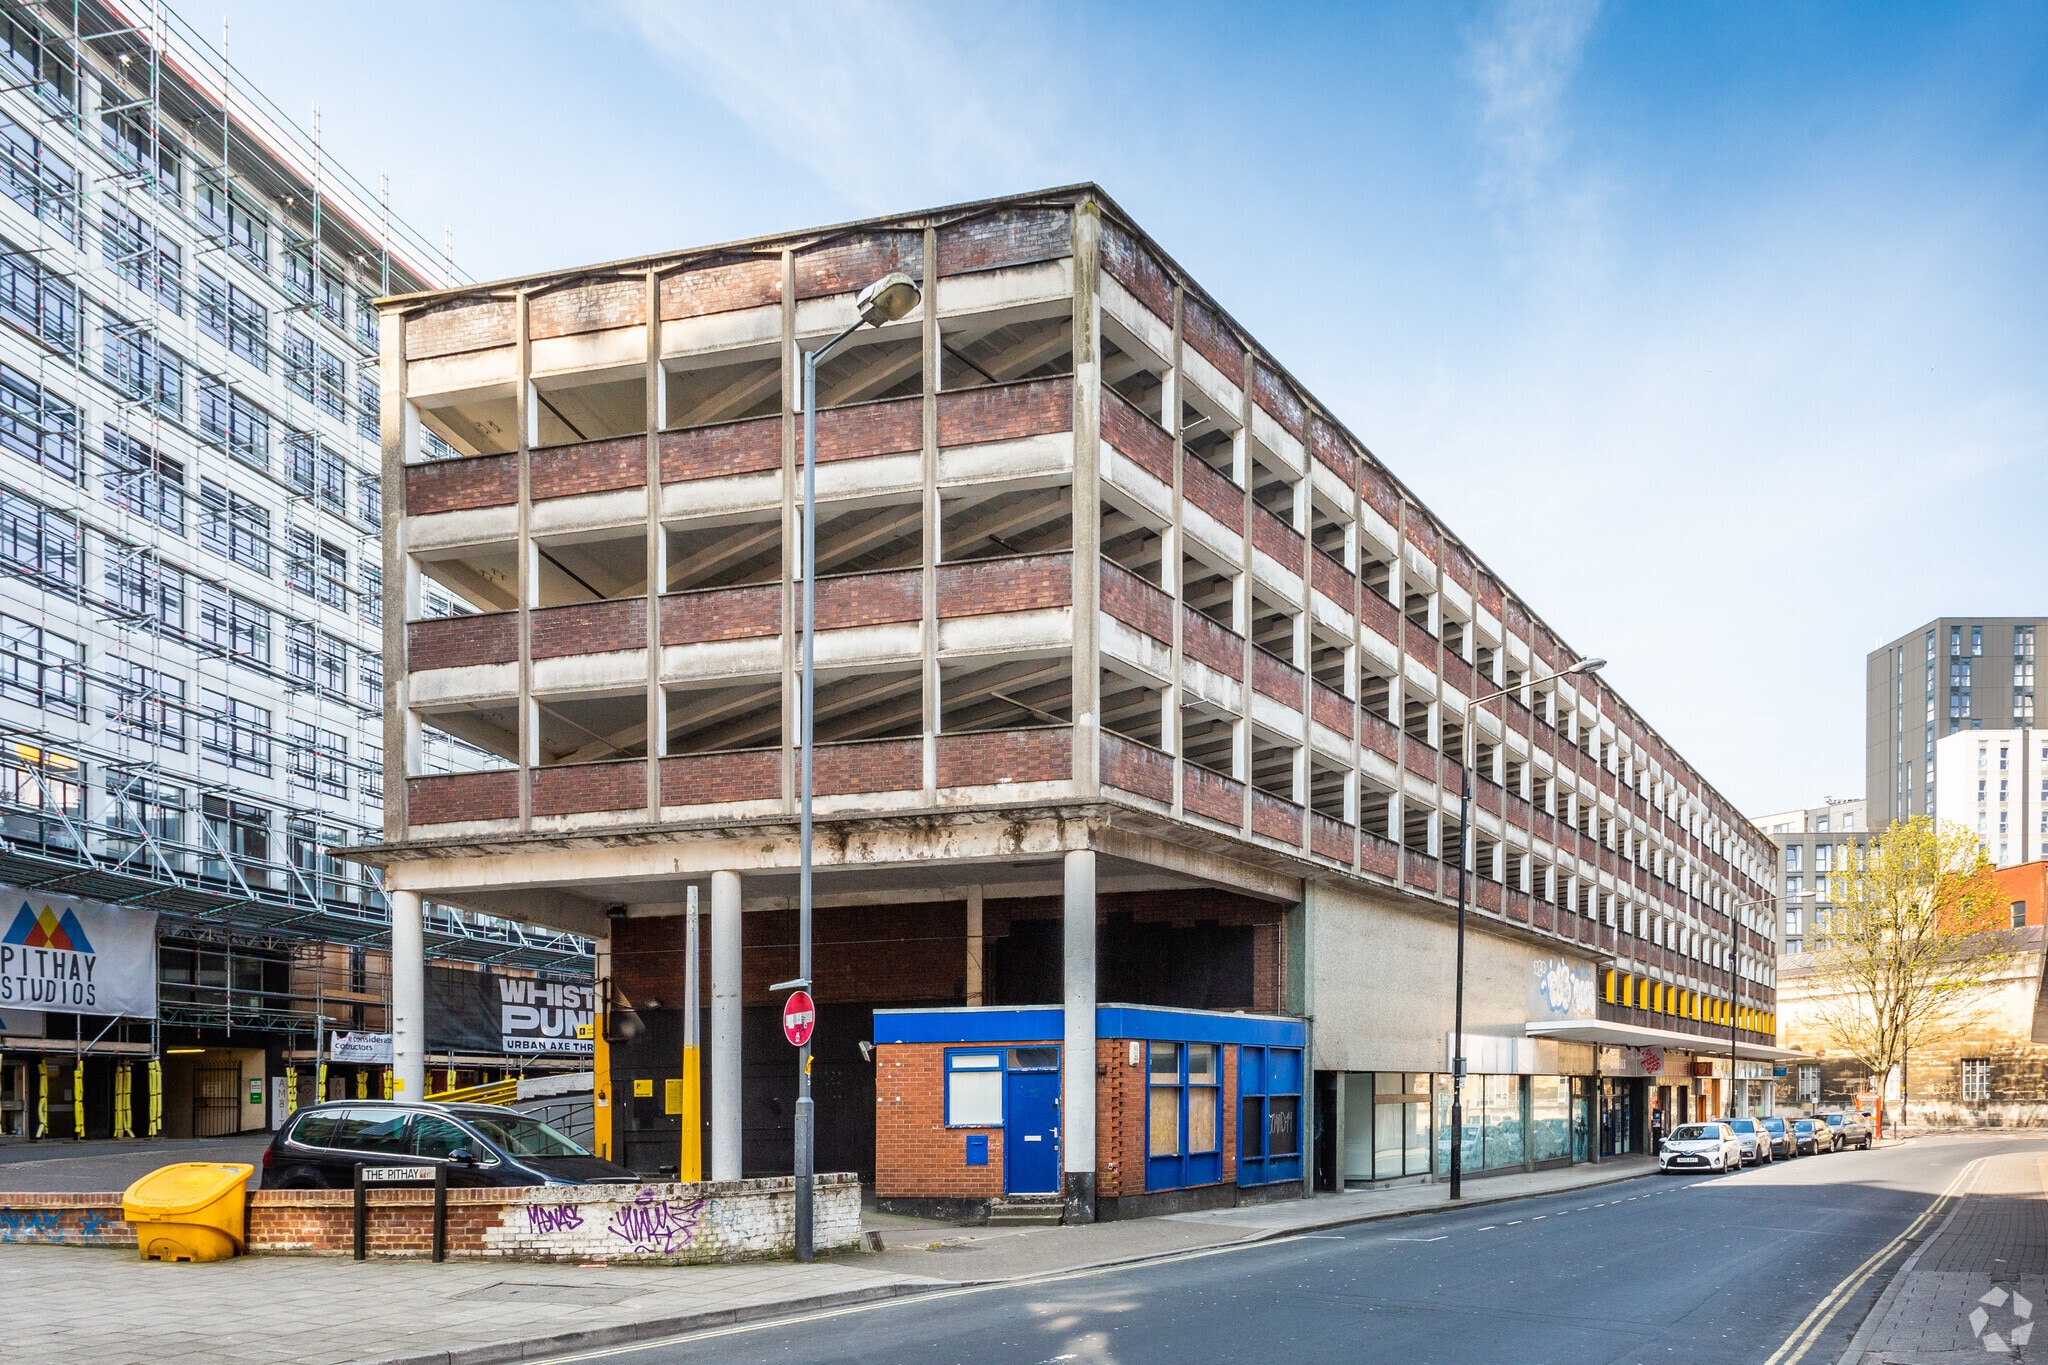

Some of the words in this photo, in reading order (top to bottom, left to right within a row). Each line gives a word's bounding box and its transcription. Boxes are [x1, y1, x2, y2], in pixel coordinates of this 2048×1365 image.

[1, 945, 97, 982] PITHAY
[1, 975, 96, 1006] STUDIOS
[507, 1040, 546, 1050] URBAN
[550, 1042, 570, 1051] AXE
[366, 1169, 384, 1180] THE
[387, 1169, 419, 1180] PITHAY
